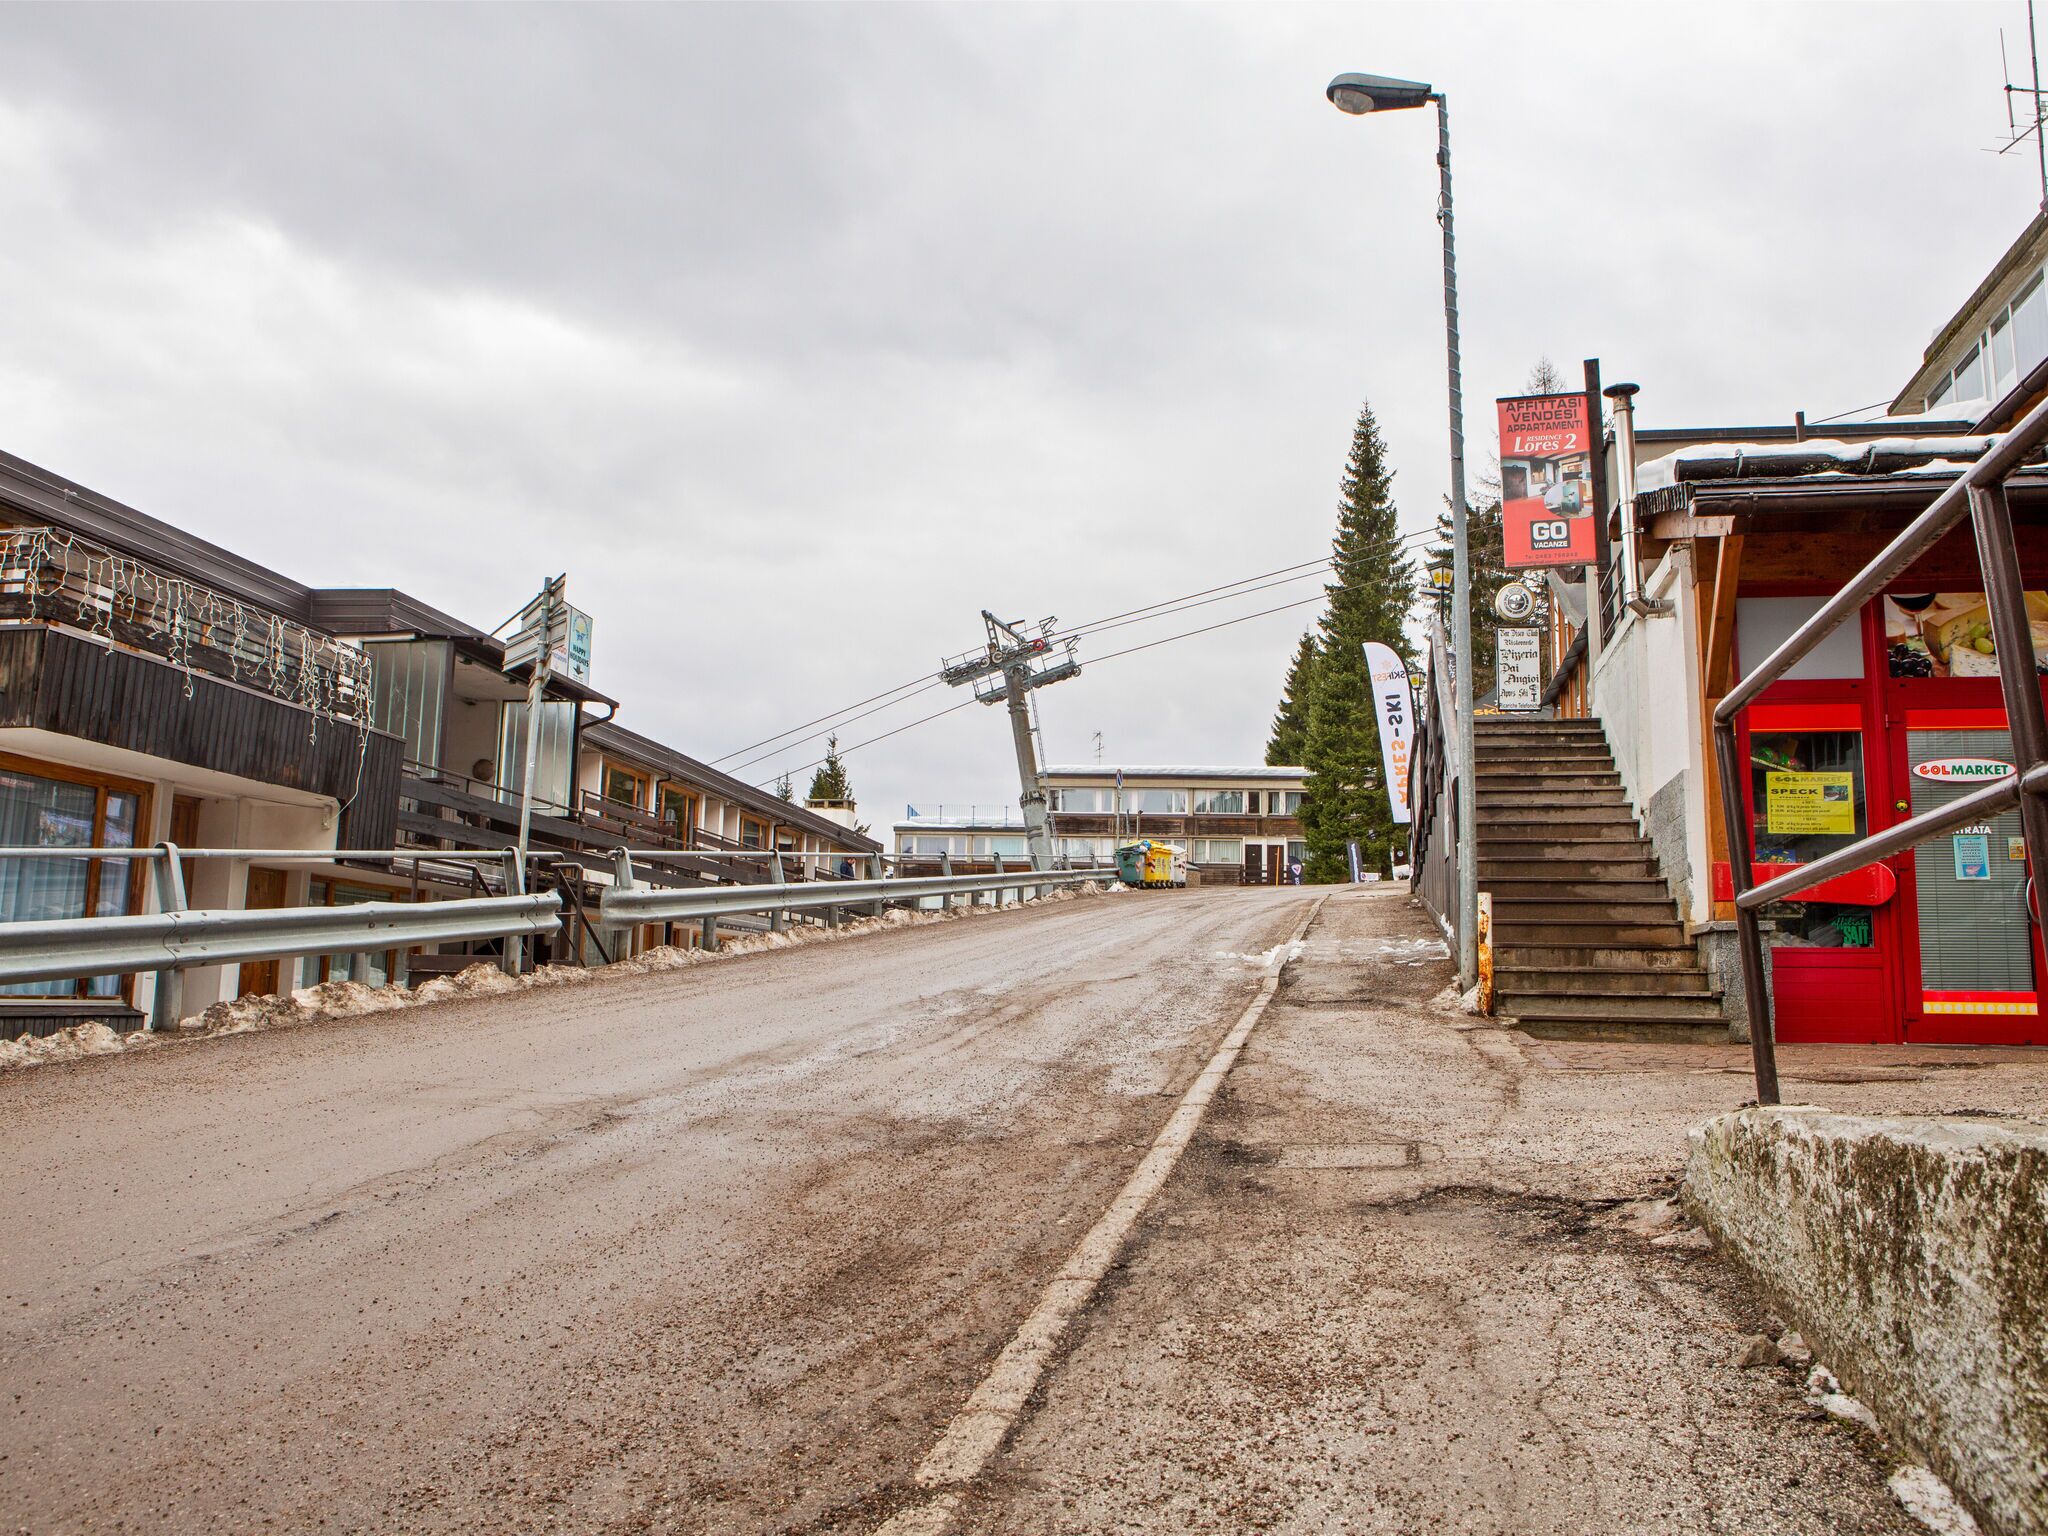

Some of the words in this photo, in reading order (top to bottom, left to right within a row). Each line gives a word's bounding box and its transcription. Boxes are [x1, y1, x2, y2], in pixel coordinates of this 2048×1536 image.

[1506, 398, 1582, 412] AFFITTASI
[1511, 409, 1577, 422] VENDESI
[1507, 420, 1583, 433] APPARTAMENTI
[1514, 437, 1559, 453] Lores
[1564, 433, 1577, 449] 2
[1526, 434, 1562, 442] RESIDENCE
[1532, 521, 1568, 540] GO
[1534, 540, 1568, 549] VACANZE
[1500, 648, 1538, 661] Pizzeria
